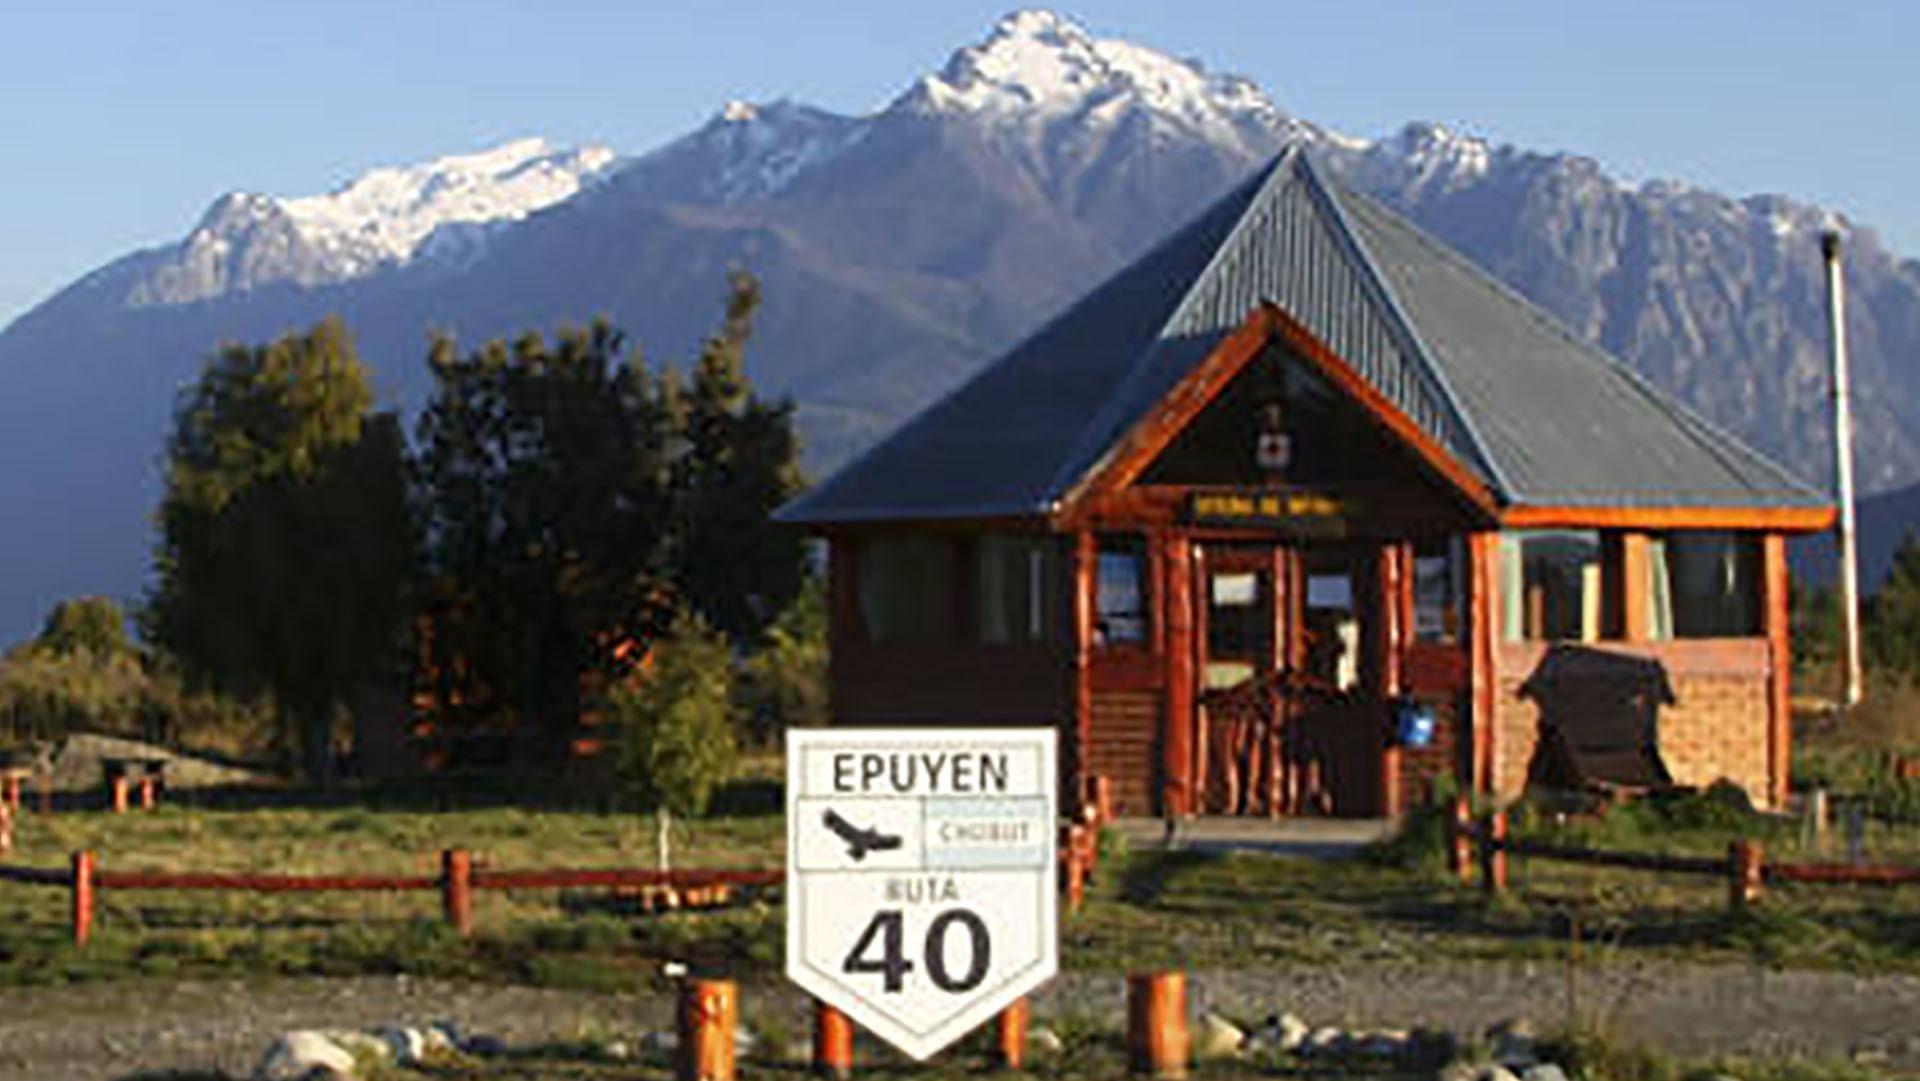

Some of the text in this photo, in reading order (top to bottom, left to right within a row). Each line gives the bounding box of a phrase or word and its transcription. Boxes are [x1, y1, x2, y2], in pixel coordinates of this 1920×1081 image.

[833, 753, 1008, 792] EPUYEN
[939, 822, 1030, 842] CHUBUT
[884, 878, 959, 902] RUTA
[842, 908, 991, 993] 40
